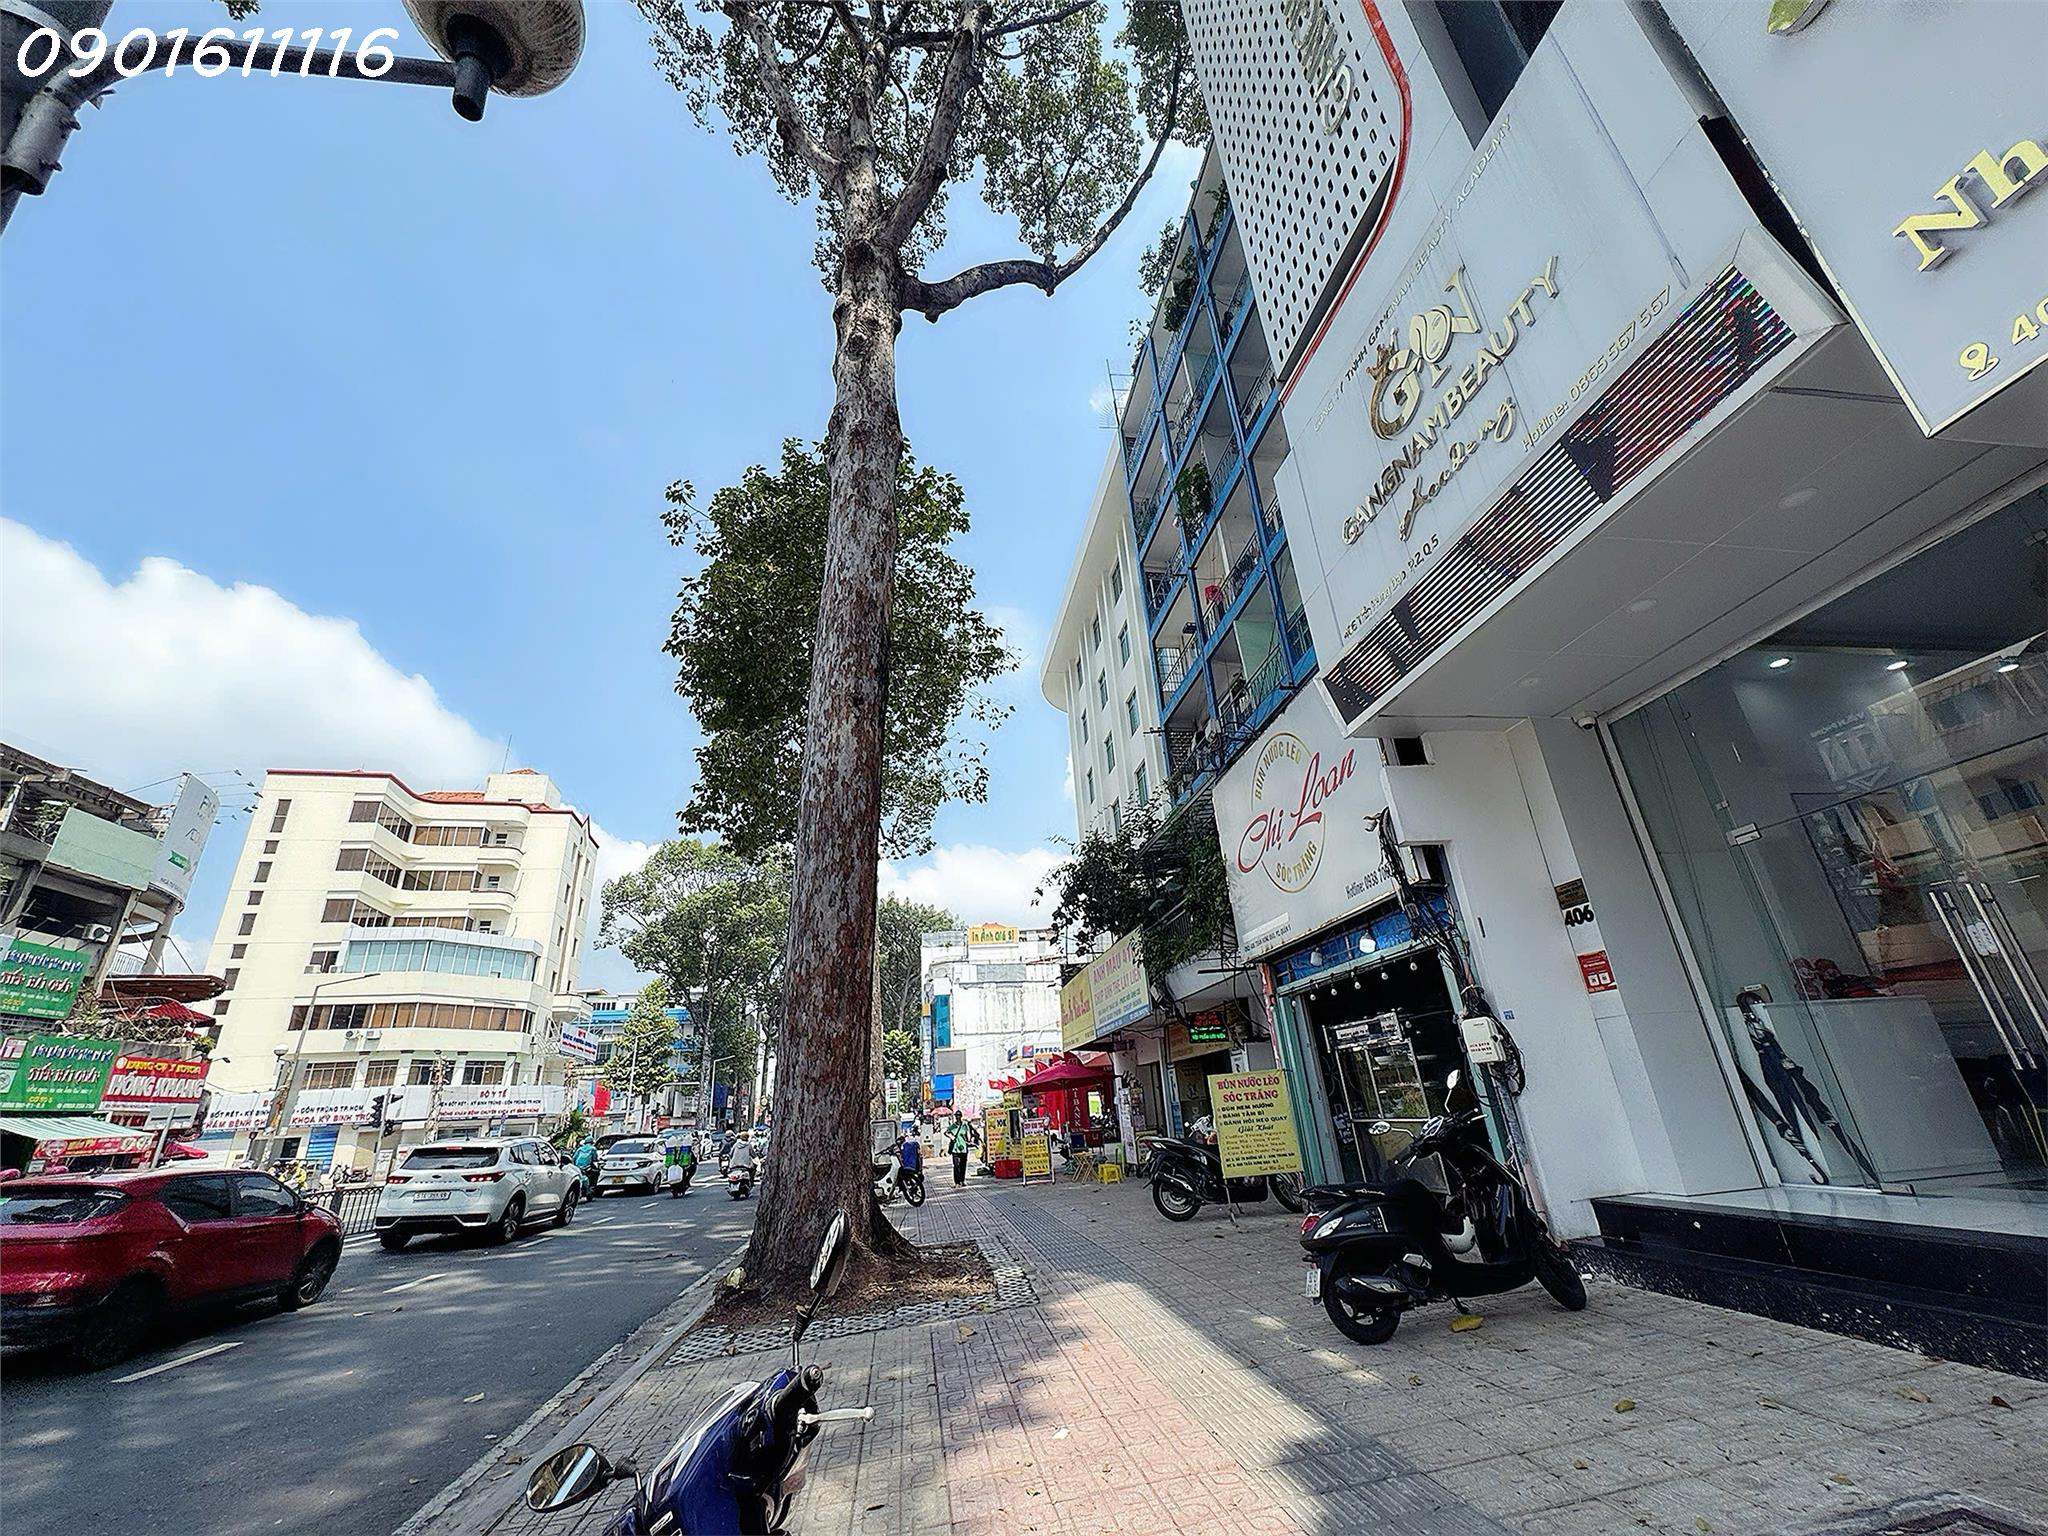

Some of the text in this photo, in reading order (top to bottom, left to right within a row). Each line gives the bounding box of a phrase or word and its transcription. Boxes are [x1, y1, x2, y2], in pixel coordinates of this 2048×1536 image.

[1345, 345, 1368, 382] TNHH
[1415, 208, 1452, 275] BEAUTY
[1456, 113, 1511, 211] ACADEMY
[1522, 283, 1671, 452] Hotline: 0865 567 567
[1237, 748, 1357, 873] Chị Loan
[1564, 904, 1595, 927] 406
[153, 1075, 205, 1099] KHANG
[1237, 1076, 1262, 1089] NƯỚC
[1263, 1074, 1280, 1086] LÈO
[1243, 1088, 1279, 1101] TRĂNG
[292, 1116, 315, 1125] KHOA
